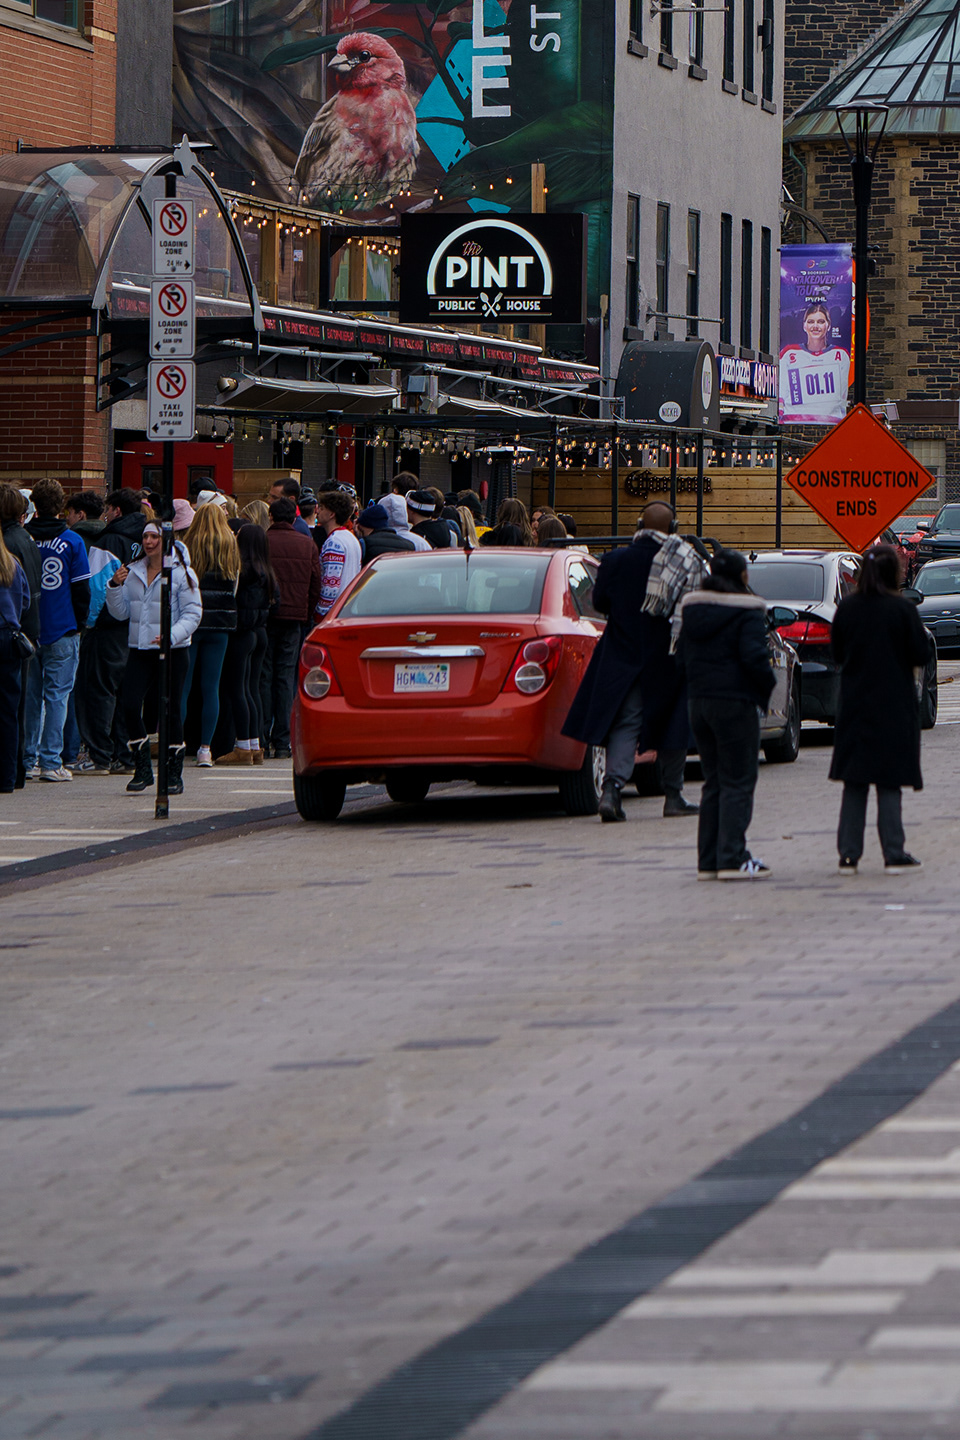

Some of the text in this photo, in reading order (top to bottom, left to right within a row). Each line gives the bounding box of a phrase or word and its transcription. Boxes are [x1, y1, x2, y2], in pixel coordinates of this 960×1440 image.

[463, 241, 483, 256] the
[446, 256, 534, 288] PINT
[438, 301, 541, 310] PUBLIC HOUSE
[835, 351, 842, 361] A
[806, 372, 835, 396] 01.11
[661, 408, 679, 417] NICKEL
[797, 470, 919, 488] CONSTRUCTION
[836, 501, 877, 516] ENDS
[396, 671, 447, 685] HGM 243
